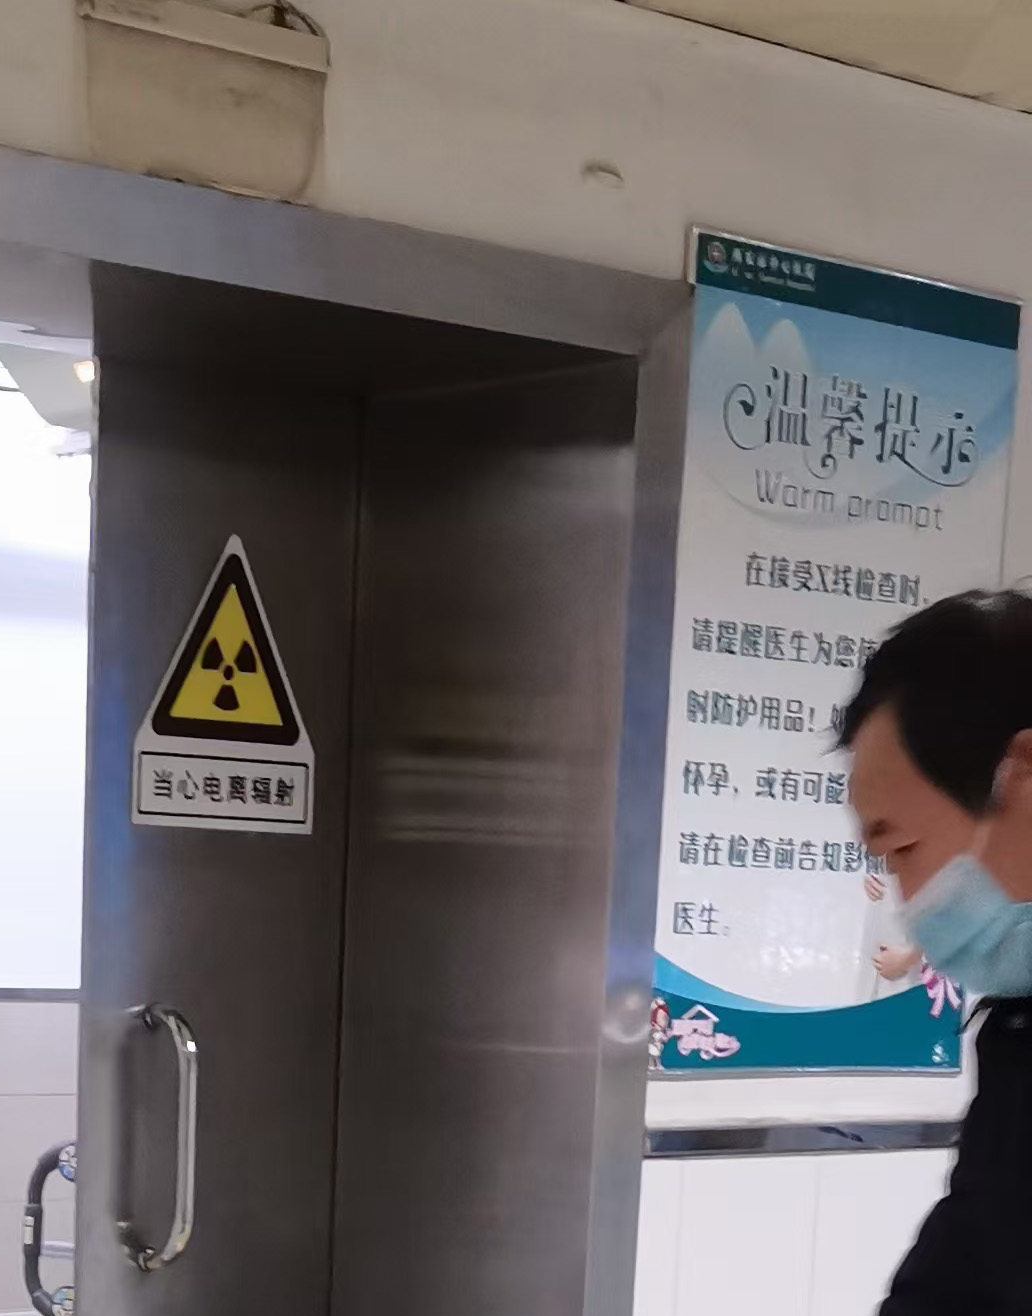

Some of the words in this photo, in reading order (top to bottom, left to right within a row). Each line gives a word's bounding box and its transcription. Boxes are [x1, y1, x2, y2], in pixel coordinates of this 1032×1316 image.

[723, 364, 979, 487] 温馨提示
[755, 467, 835, 514] Warm
[848, 494, 944, 533] prompt
